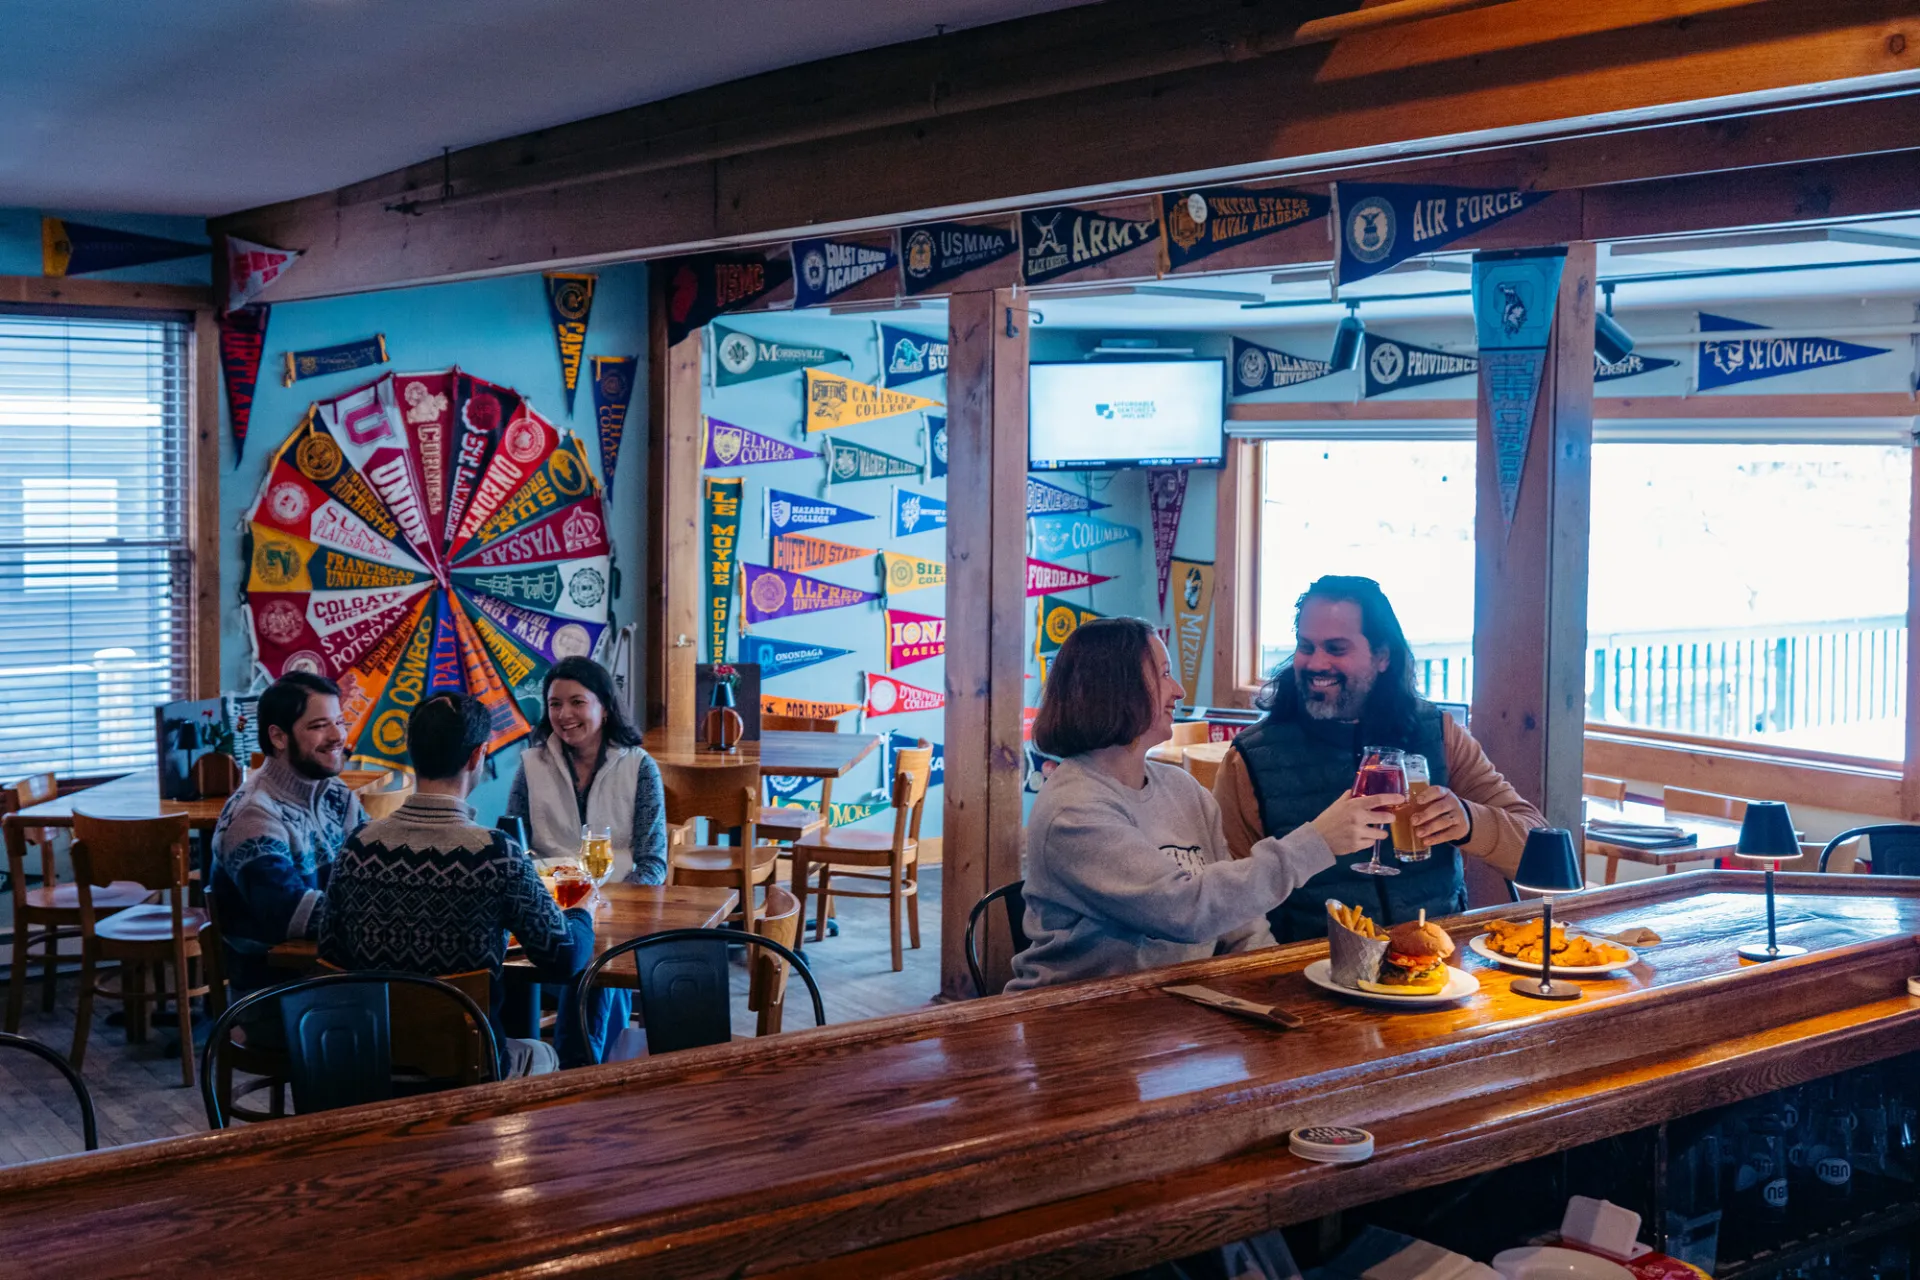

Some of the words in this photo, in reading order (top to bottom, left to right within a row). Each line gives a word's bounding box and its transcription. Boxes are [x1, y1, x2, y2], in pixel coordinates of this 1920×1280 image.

[1208, 197, 1258, 215] UNITED
[1259, 198, 1309, 212] STATES
[1413, 199, 1449, 242] AIR
[1455, 192, 1523, 229] FORCE
[1072, 216, 1155, 263] ARMY
[1212, 216, 1249, 242] NAVAL
[1252, 207, 1311, 231] ACADEMY
[825, 243, 856, 268] COAST
[857, 248, 887, 264] GUARD
[941, 231, 1005, 256] USMMA
[826, 262, 887, 294] ACADEMY
[1027, 257, 1046, 276] BLACK
[715, 263, 764, 307] USMC
[561, 321, 586, 390] CANTON
[1267, 351, 1332, 371] VILLANOVA
[1407, 350, 1478, 376] PROVIDENCE
[1593, 356, 1644, 376] VERSITY
[1749, 340, 1799, 371] SETON
[1801, 345, 1844, 365] HALL
[222, 331, 262, 439] ORTLAND
[1273, 367, 1330, 387] UNIVERSITY
[1490, 361, 1535, 401] THE
[856, 402, 913, 417] COLLEGE
[459, 432, 489, 467] ST
[741, 447, 795, 463] COLLEGE
[743, 431, 794, 454] ELMIRA
[1494, 408, 1527, 491] CITADEL
[417, 423, 442, 516] CORNELL
[859, 449, 887, 477] WAGNER
[888, 459, 917, 474] COLLEGE
[330, 474, 400, 540] ROCHESTER
[345, 467, 391, 520] UNIVERSITY
[369, 455, 430, 546] UNION
[443, 465, 477, 541] LAWRENCE
[457, 454, 523, 540] ONEONTA
[477, 470, 549, 541] BROCKPORT
[711, 491, 738, 516] LE
[1026, 480, 1089, 513] GENESEO
[479, 486, 557, 546] SUNY
[791, 505, 837, 516] NAZARETH
[791, 515, 830, 523] COLLEGE
[313, 519, 393, 560] PLATTSBURGH
[325, 506, 388, 550] SUNY
[479, 523, 562, 565] VASSAR
[1071, 521, 1130, 549] COLUMBIA
[324, 551, 416, 579] FRANCISCAN
[711, 524, 737, 586] MOYNE
[776, 536, 827, 572] BUFFALO
[827, 544, 862, 562] STATE
[916, 562, 946, 576] SIE
[325, 570, 414, 588] UNIVERSITY
[475, 567, 559, 604] DELHI
[792, 578, 863, 603] ALFRED
[918, 576, 946, 586] COLL
[1026, 564, 1090, 590] FORDHAM
[313, 591, 403, 619] COLGATE
[323, 599, 394, 626] HOCKEY
[472, 594, 515, 627] YORK
[479, 592, 552, 629] UNIVERSITY
[793, 596, 859, 611] UNIVERSITY
[330, 605, 409, 673] POTSDAM
[511, 618, 551, 651] NEW
[713, 597, 728, 664] COLLE
[1179, 611, 1204, 680] MIZZOU
[389, 615, 433, 706] OSWEGO
[432, 614, 461, 688] PALTZ
[474, 616, 530, 687] HERKIMER
[775, 648, 823, 662] ONONDAGA
[902, 645, 945, 658] GAELS
[903, 699, 939, 711] COLLEGE
